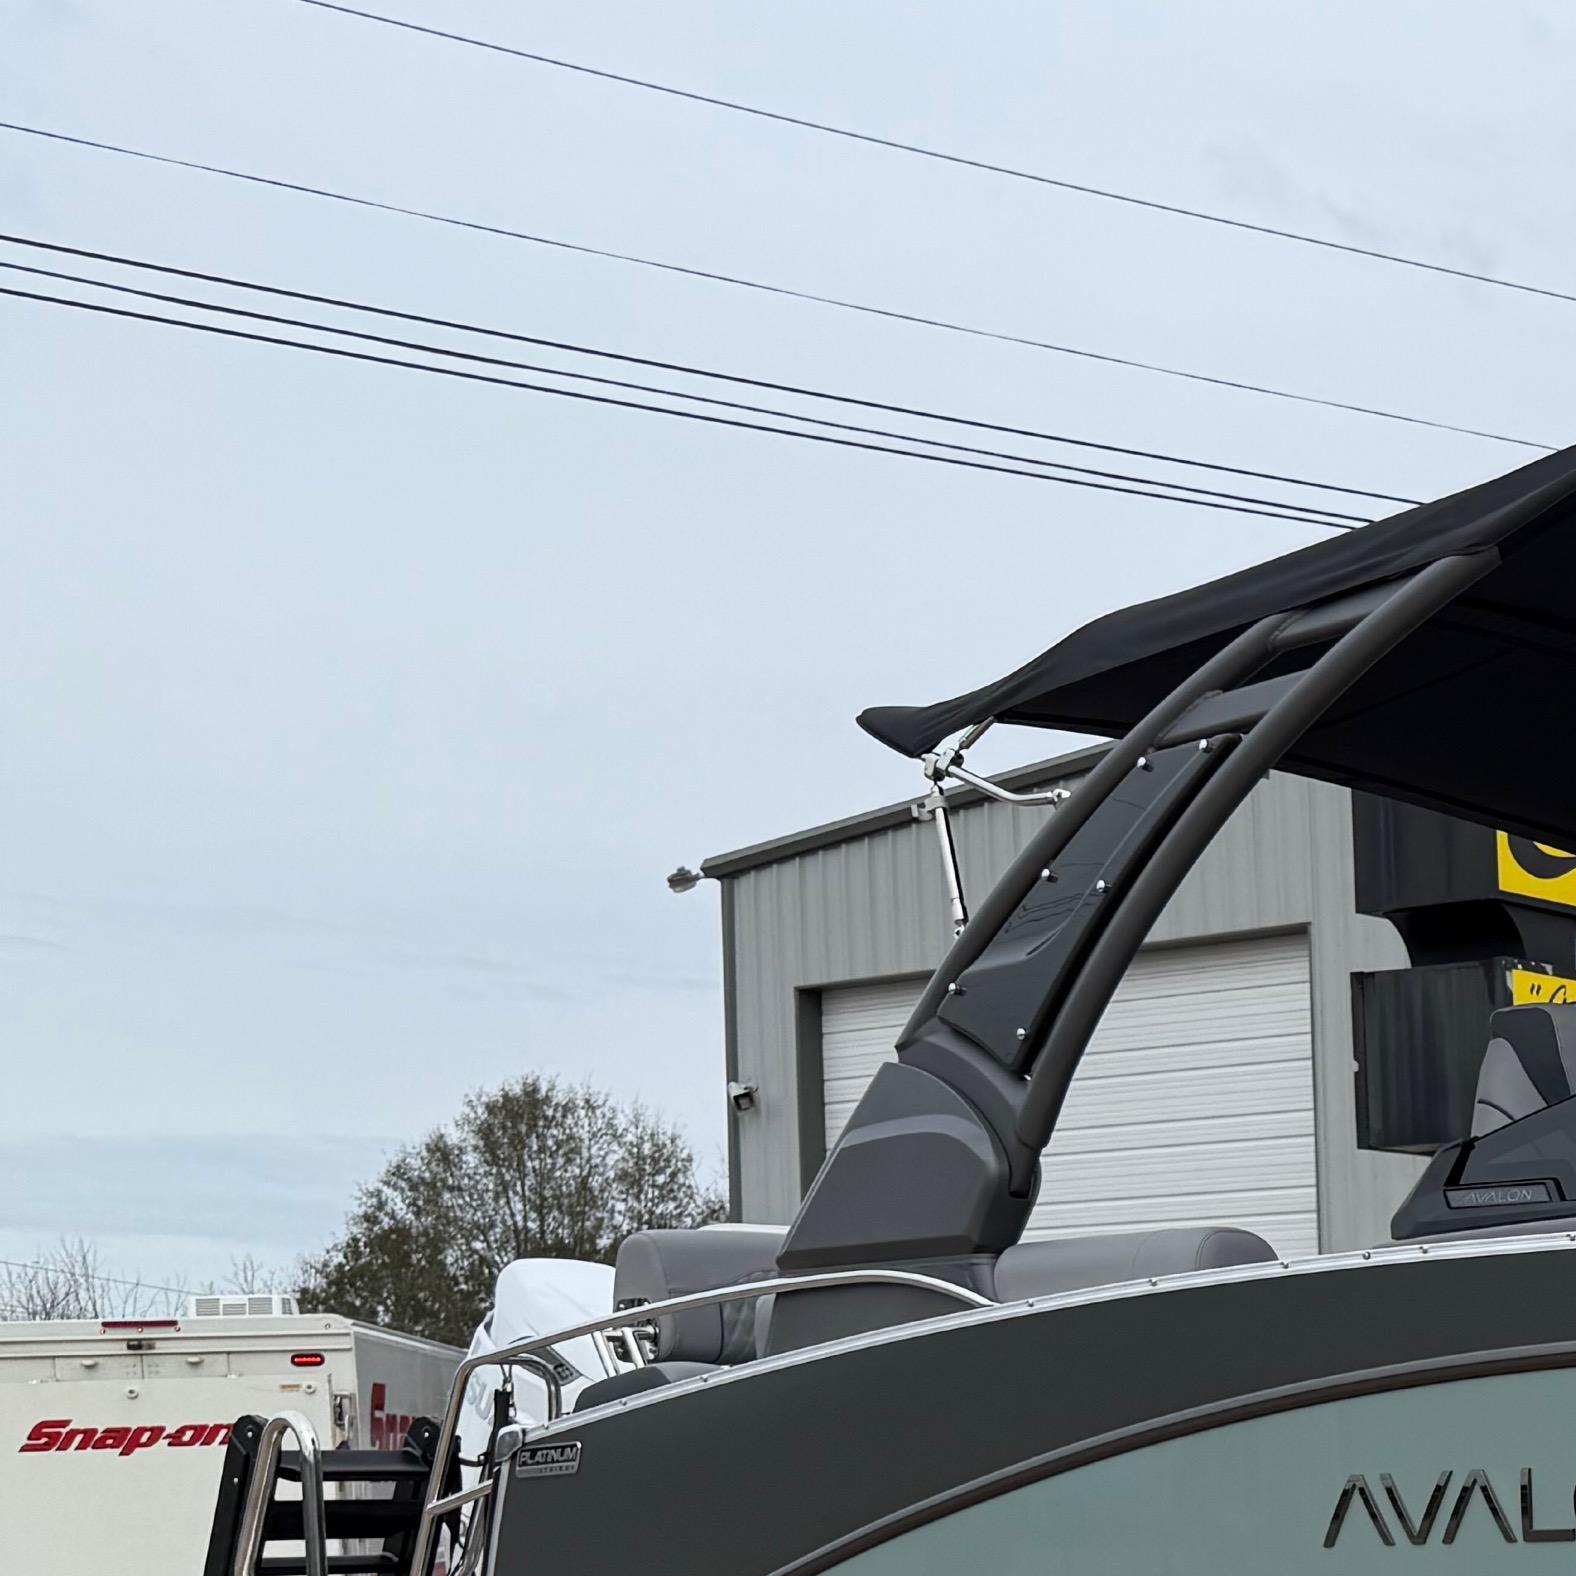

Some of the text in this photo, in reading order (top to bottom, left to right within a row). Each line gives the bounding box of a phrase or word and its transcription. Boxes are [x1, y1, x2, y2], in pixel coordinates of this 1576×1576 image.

[1464, 1189, 1533, 1203] AVALON
[18, 1419, 233, 1456] Snap-on
[520, 1446, 577, 1465] PLATINUM
